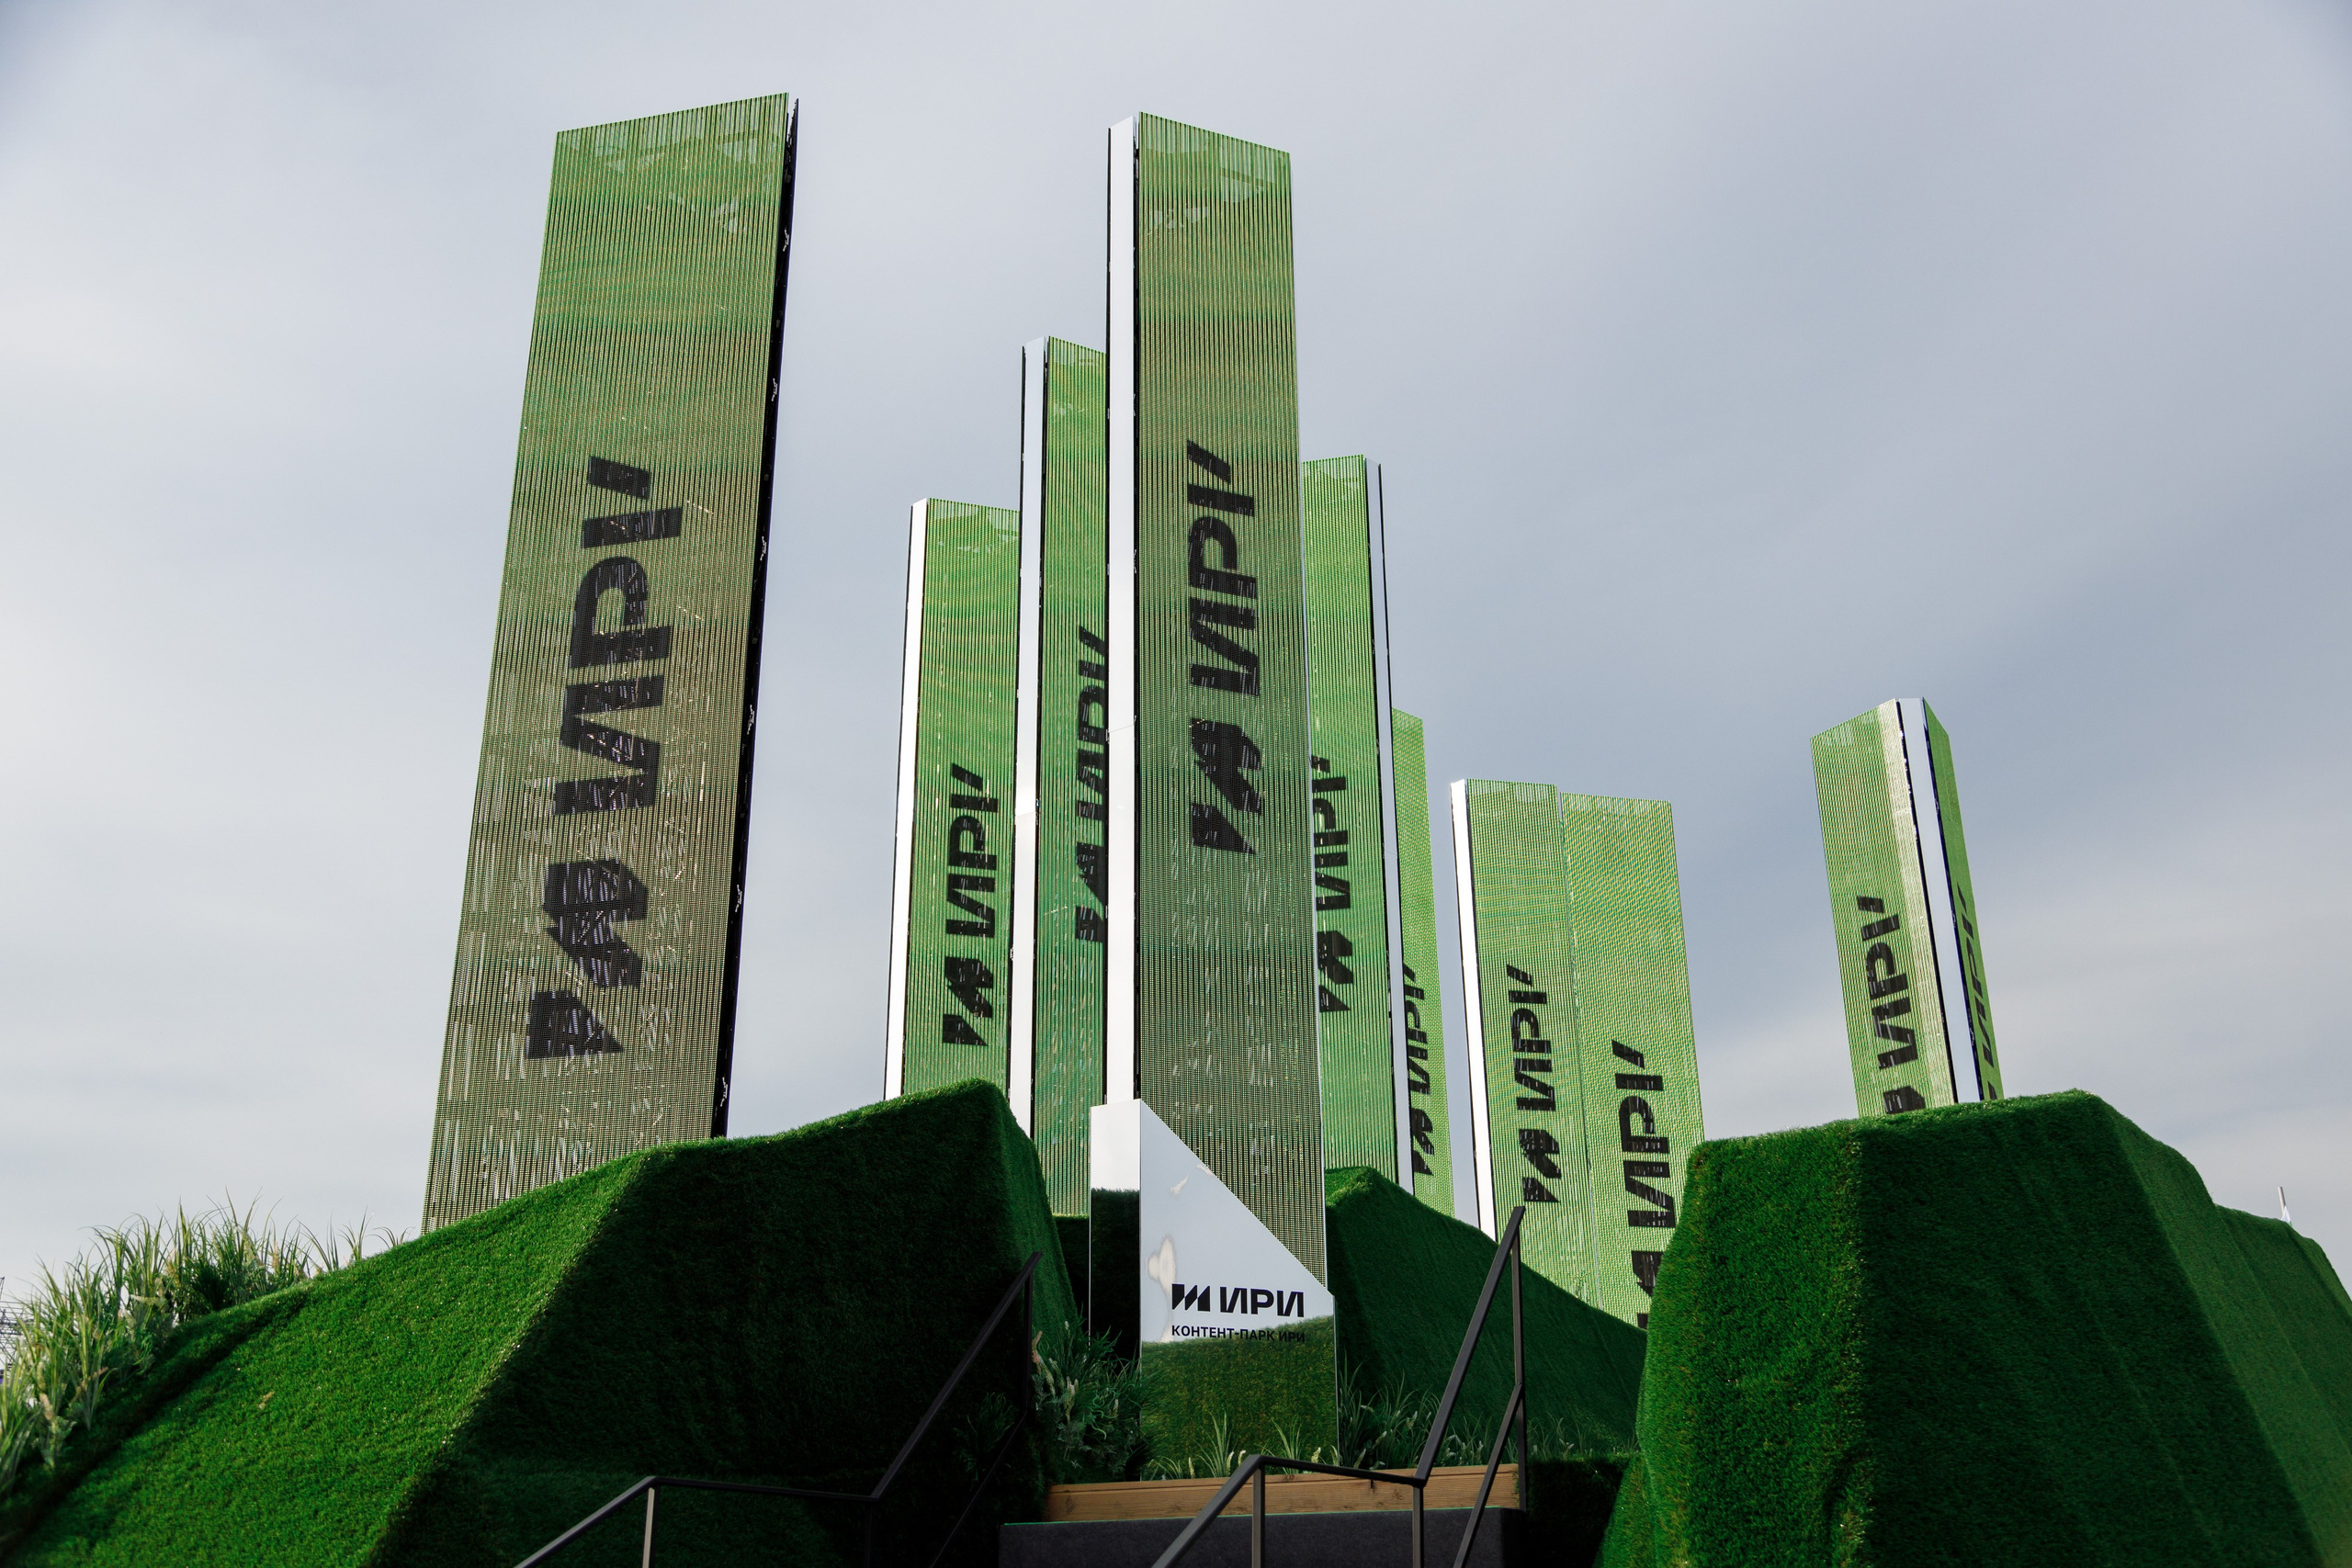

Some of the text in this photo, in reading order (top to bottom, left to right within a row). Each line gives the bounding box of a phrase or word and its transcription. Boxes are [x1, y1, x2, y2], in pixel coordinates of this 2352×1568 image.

[1219, 1286, 1305, 1317] ИРИ
[1171, 1325, 1306, 1344] КОНТЕНТ-ПАРК ИРИ
